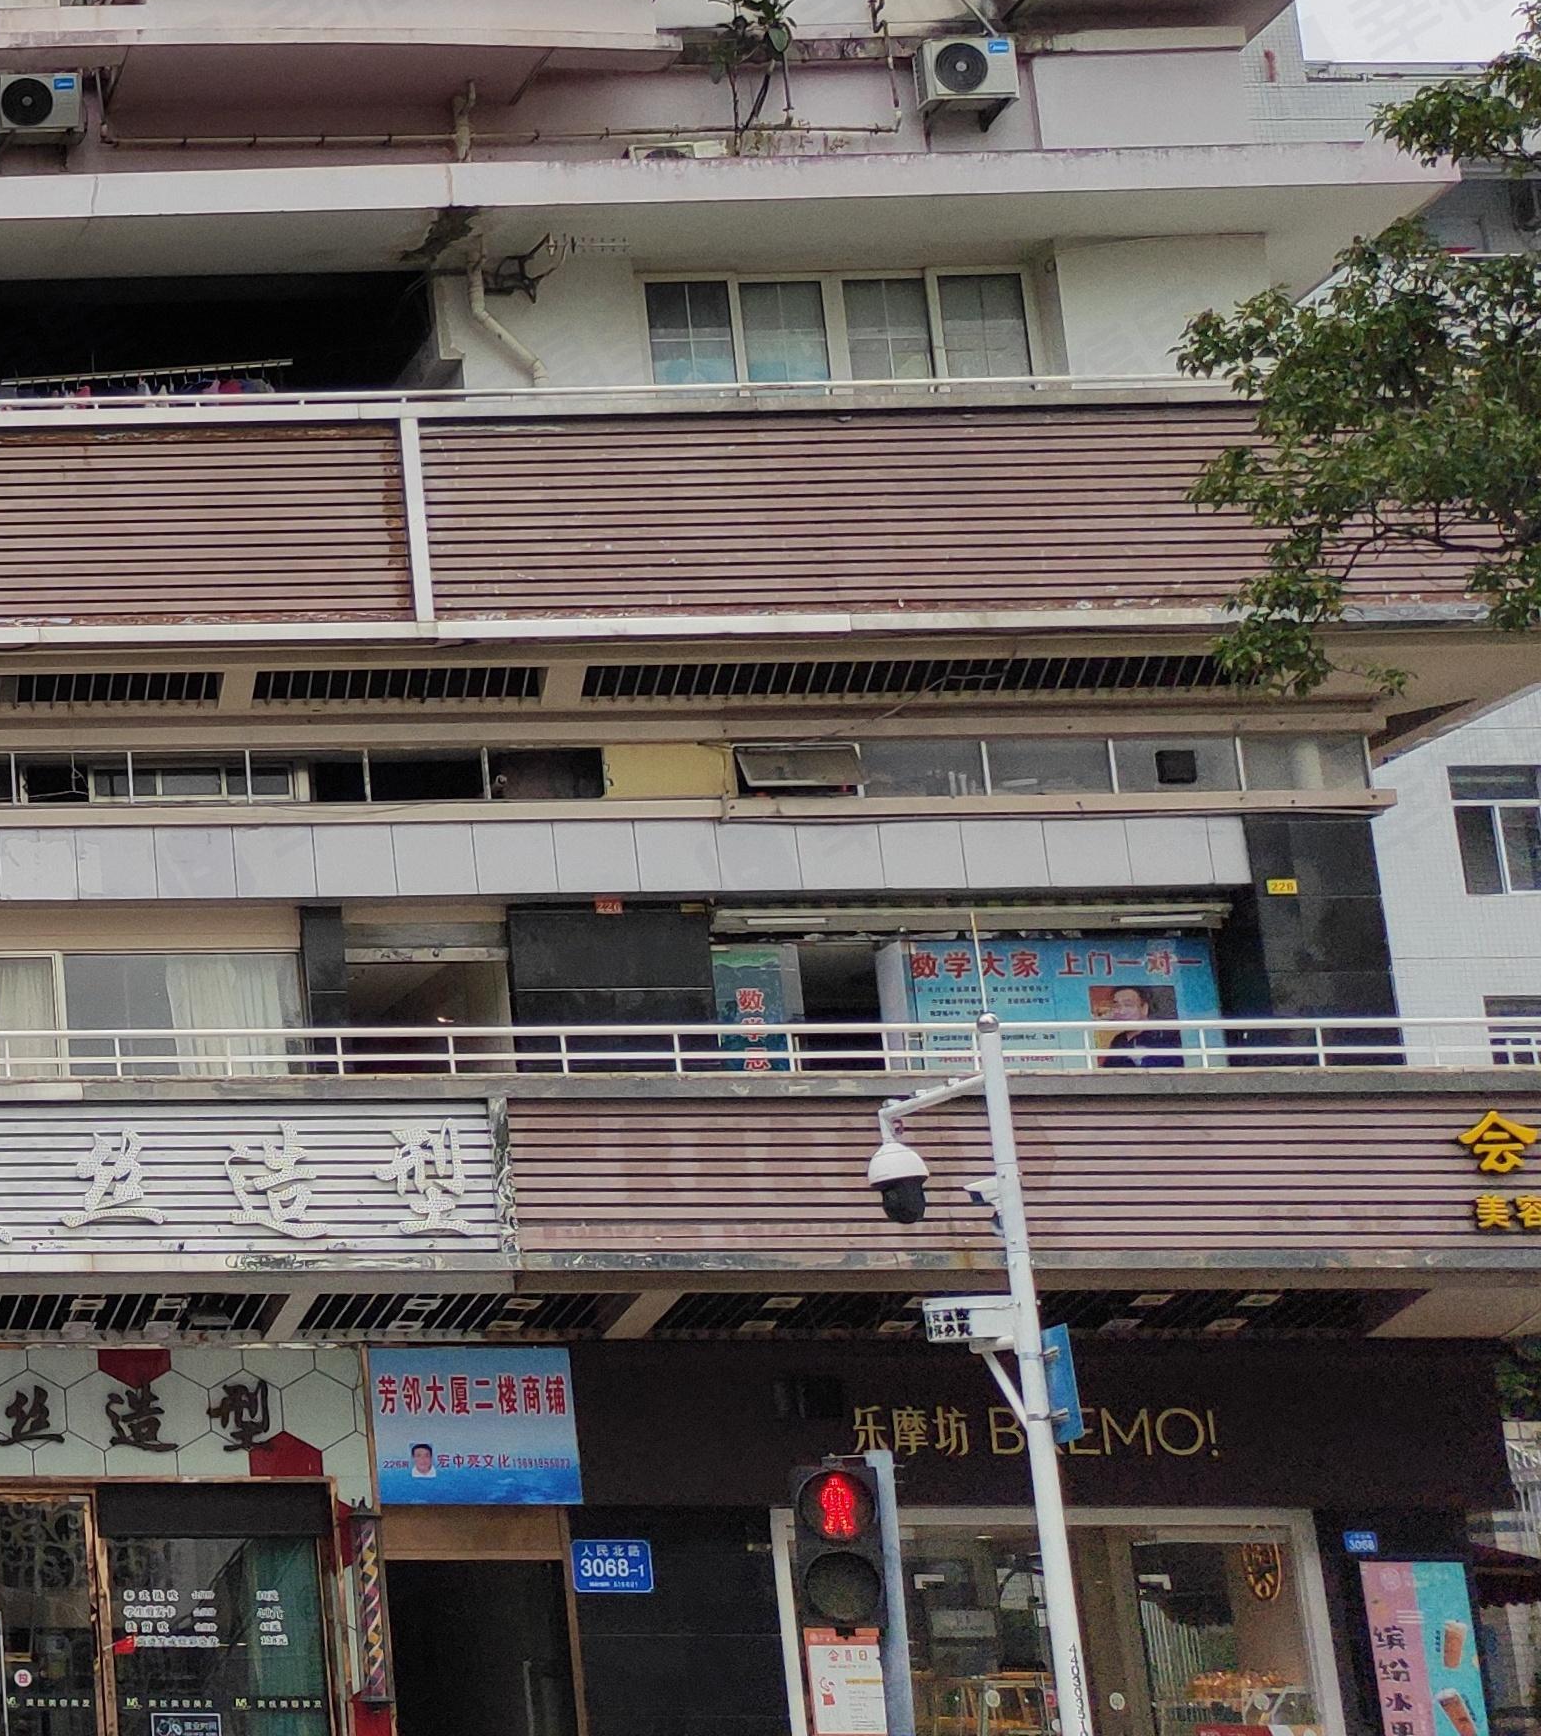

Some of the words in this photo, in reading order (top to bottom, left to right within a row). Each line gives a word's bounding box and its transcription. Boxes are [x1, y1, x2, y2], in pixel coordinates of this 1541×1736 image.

[911, 951, 1040, 978] 数学大家
[1059, 951, 1204, 977] 上门一对一
[377, 1373, 568, 1418] 芳邻大厦二楼商铺
[851, 1406, 970, 1458] 乐摩坊
[990, 1406, 1220, 1458] BEMO!
[579, 1557, 645, 1578] 3068-1
